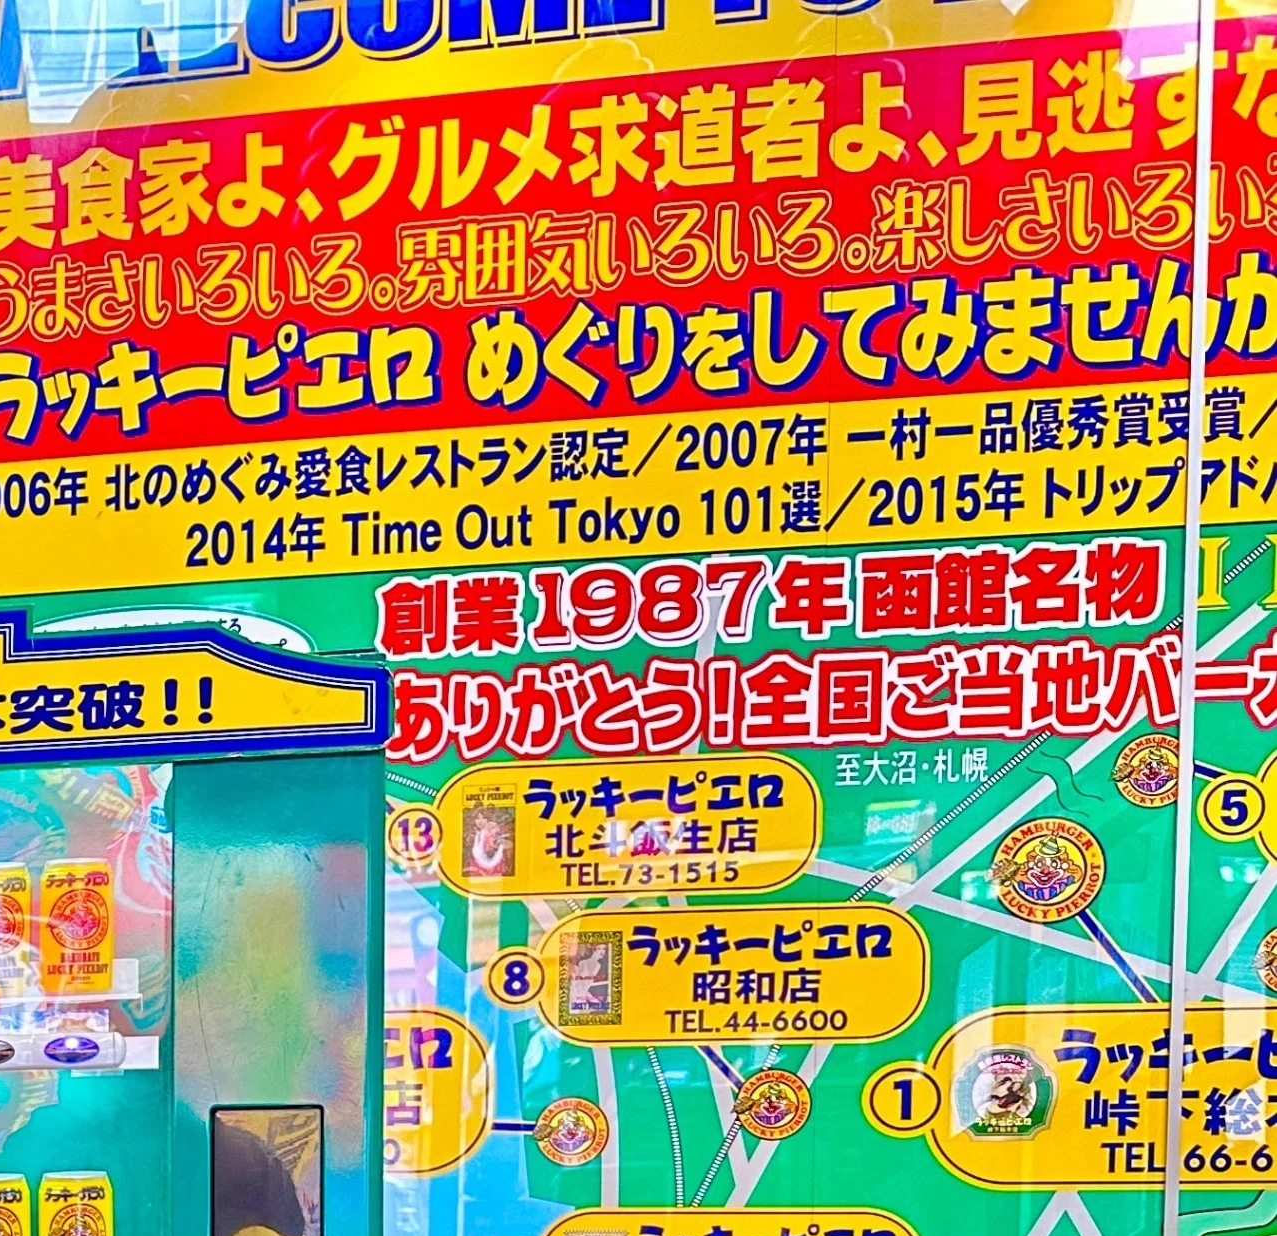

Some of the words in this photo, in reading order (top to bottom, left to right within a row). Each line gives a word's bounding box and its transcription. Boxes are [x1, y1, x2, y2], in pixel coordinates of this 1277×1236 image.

[186, 513, 325, 567] 2014年
[348, 510, 441, 556] Time
[456, 505, 533, 549] Out
[548, 497, 681, 546] Tokyo
[835, 747, 989, 787] 至大沼・札幌
[523, 772, 784, 819] ラッキーピエロ
[1220, 790, 1248, 826] 5
[396, 819, 433, 853] 13
[545, 819, 757, 857] 北斗飯生店
[1000, 821, 1097, 858] HAMBURGER
[560, 861, 740, 886] TEL.73-1515
[1003, 889, 1053, 920] LUCKY
[1056, 861, 1103, 918] PIERROT
[627, 922, 893, 966] ラッキーピエロ
[503, 962, 530, 993] 8
[692, 968, 822, 1004] 昭和店
[665, 1010, 848, 1035] TEL.44-6600
[893, 1080, 913, 1121] 1
